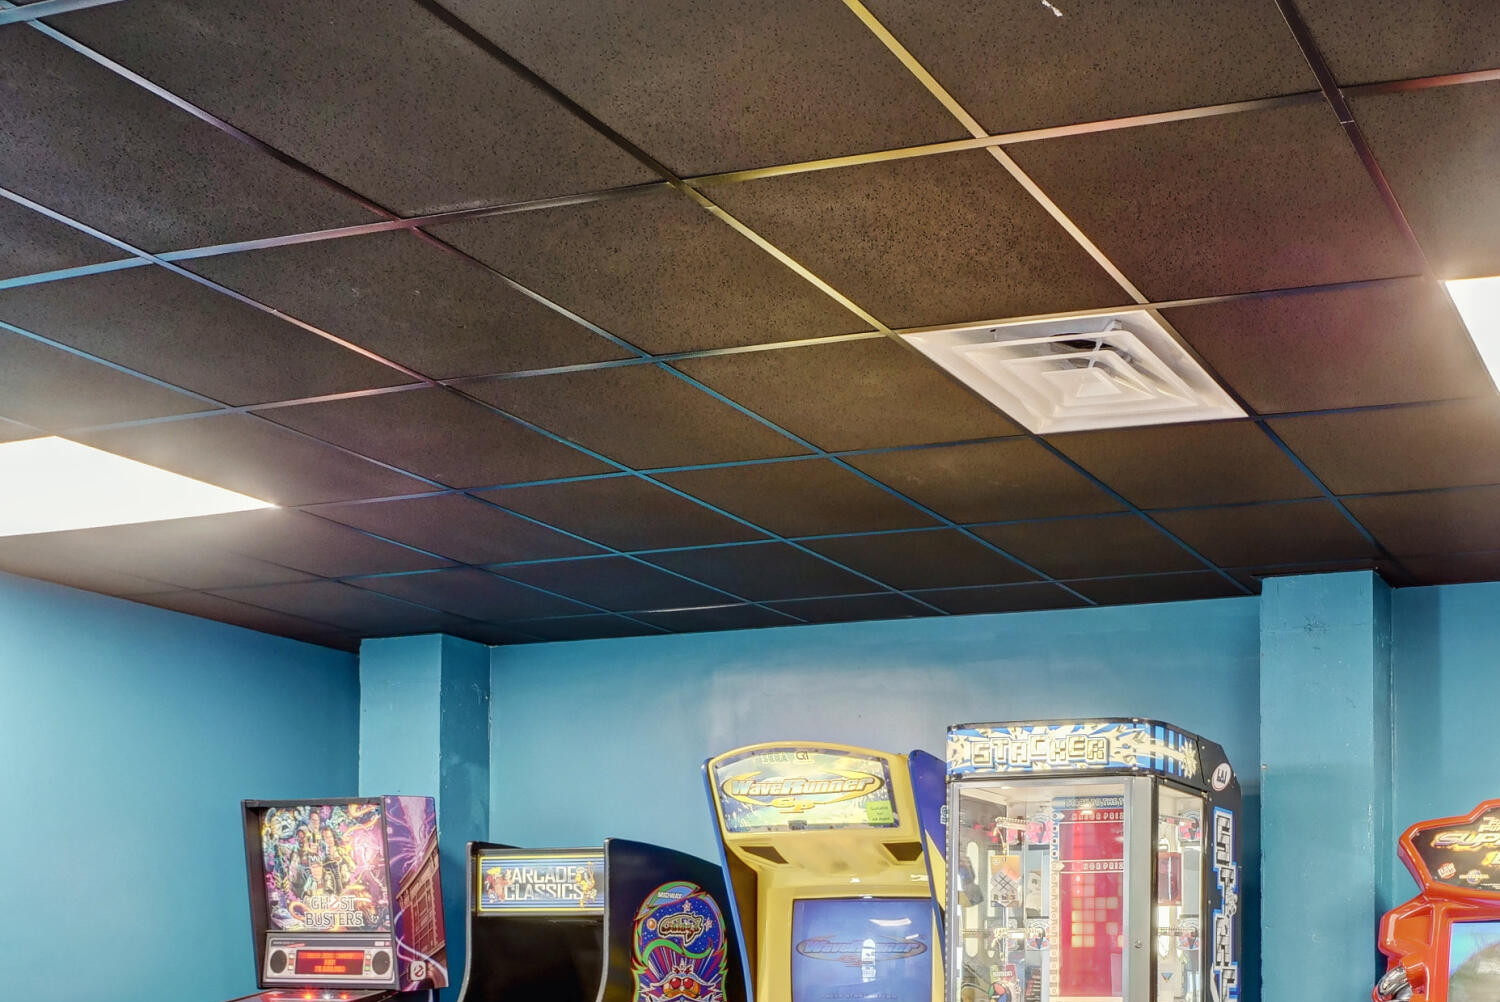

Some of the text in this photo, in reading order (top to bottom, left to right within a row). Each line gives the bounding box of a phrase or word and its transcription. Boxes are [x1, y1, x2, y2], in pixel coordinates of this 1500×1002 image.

[971, 734, 1109, 769] STACKER
[511, 866, 578, 884] ARCADE
[503, 883, 584, 901] CLASSICS
[304, 911, 365, 928] BUSTERS
